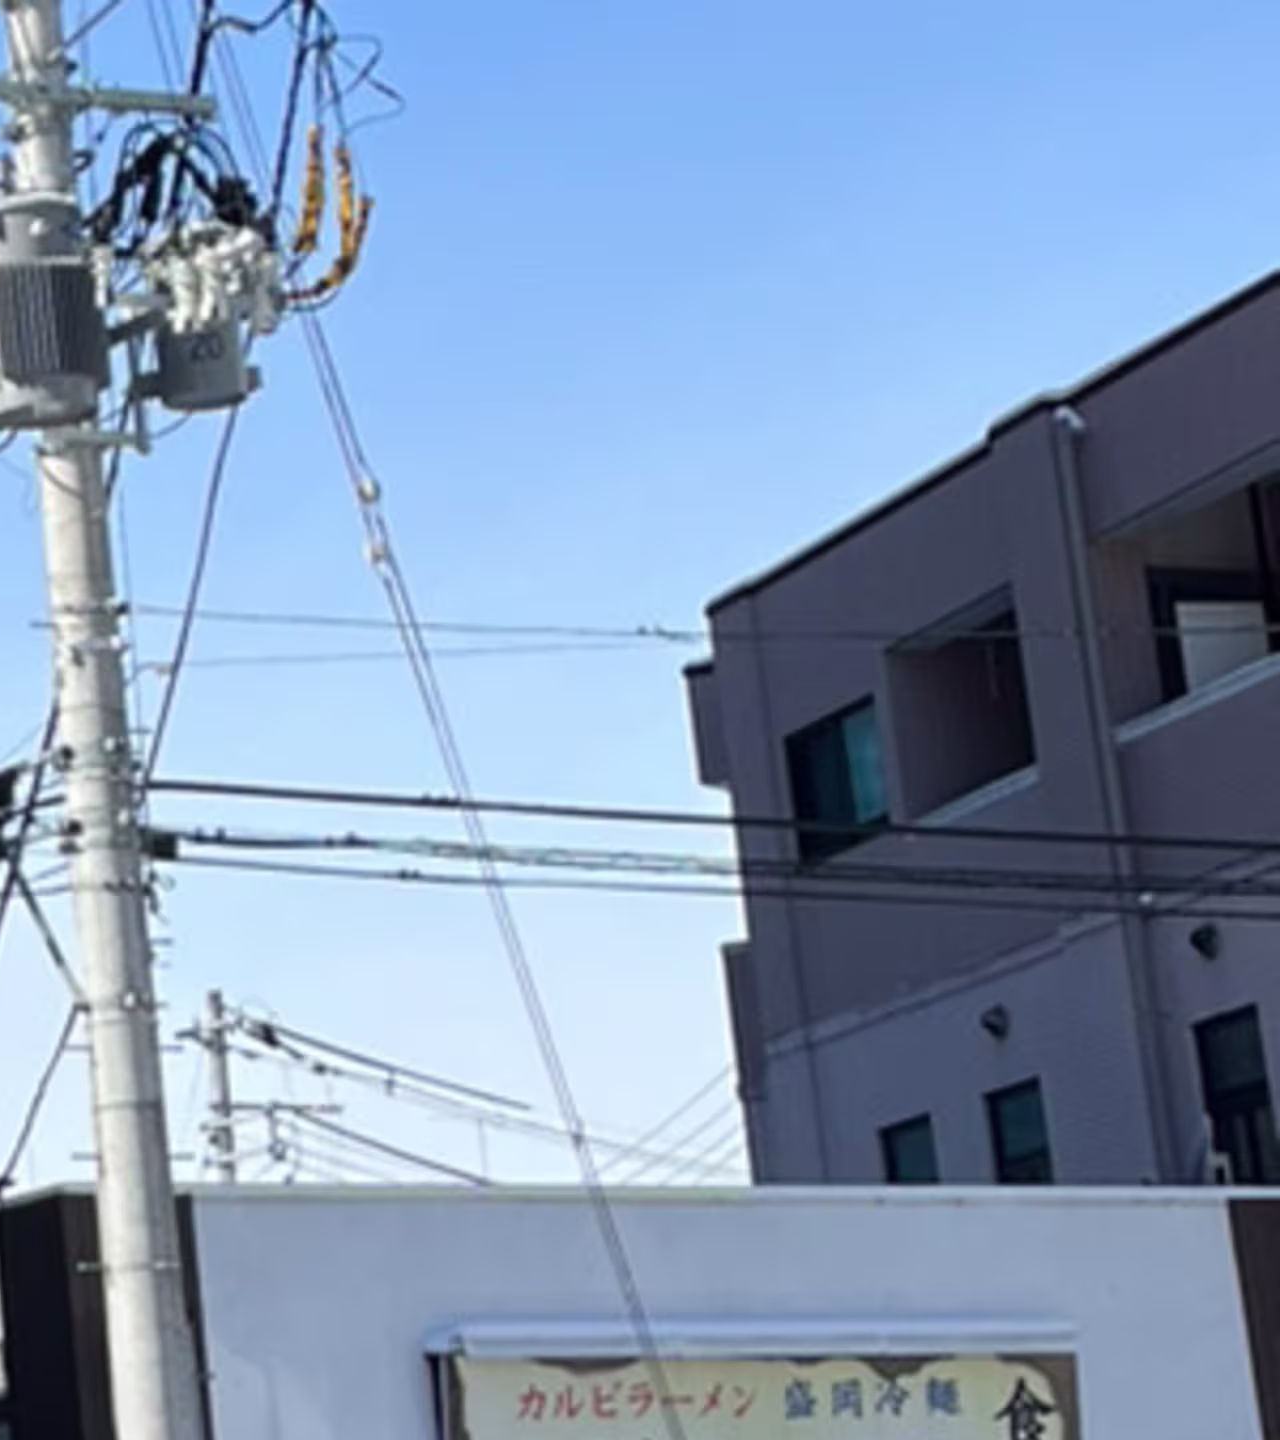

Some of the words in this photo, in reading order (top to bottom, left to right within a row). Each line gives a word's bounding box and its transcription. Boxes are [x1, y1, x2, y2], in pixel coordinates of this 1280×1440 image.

[516, 1381, 757, 1420] カルビラーメン
